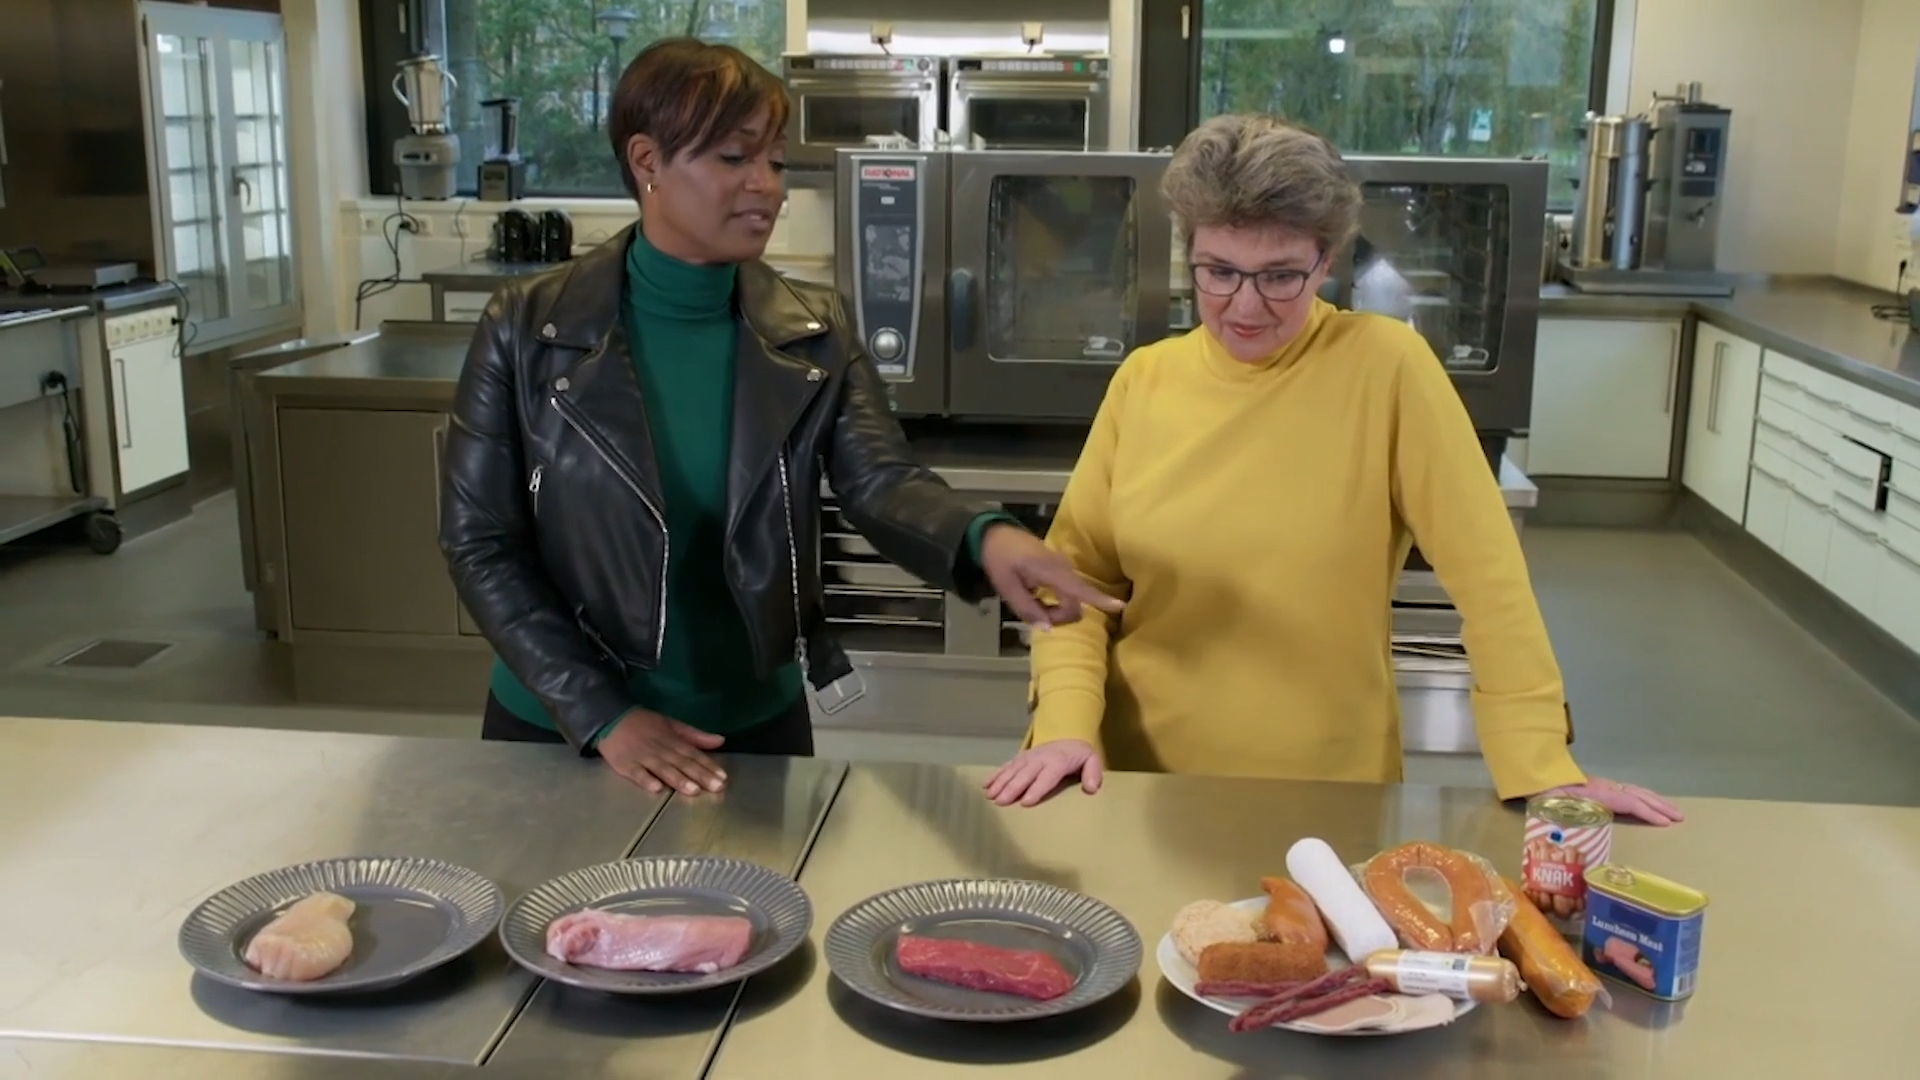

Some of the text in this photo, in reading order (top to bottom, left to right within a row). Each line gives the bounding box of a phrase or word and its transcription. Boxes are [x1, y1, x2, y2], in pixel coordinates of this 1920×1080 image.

[1532, 866, 1574, 887] KNAK
[1592, 915, 1638, 942] Luncheon
[1639, 933, 1664, 953] Meat
